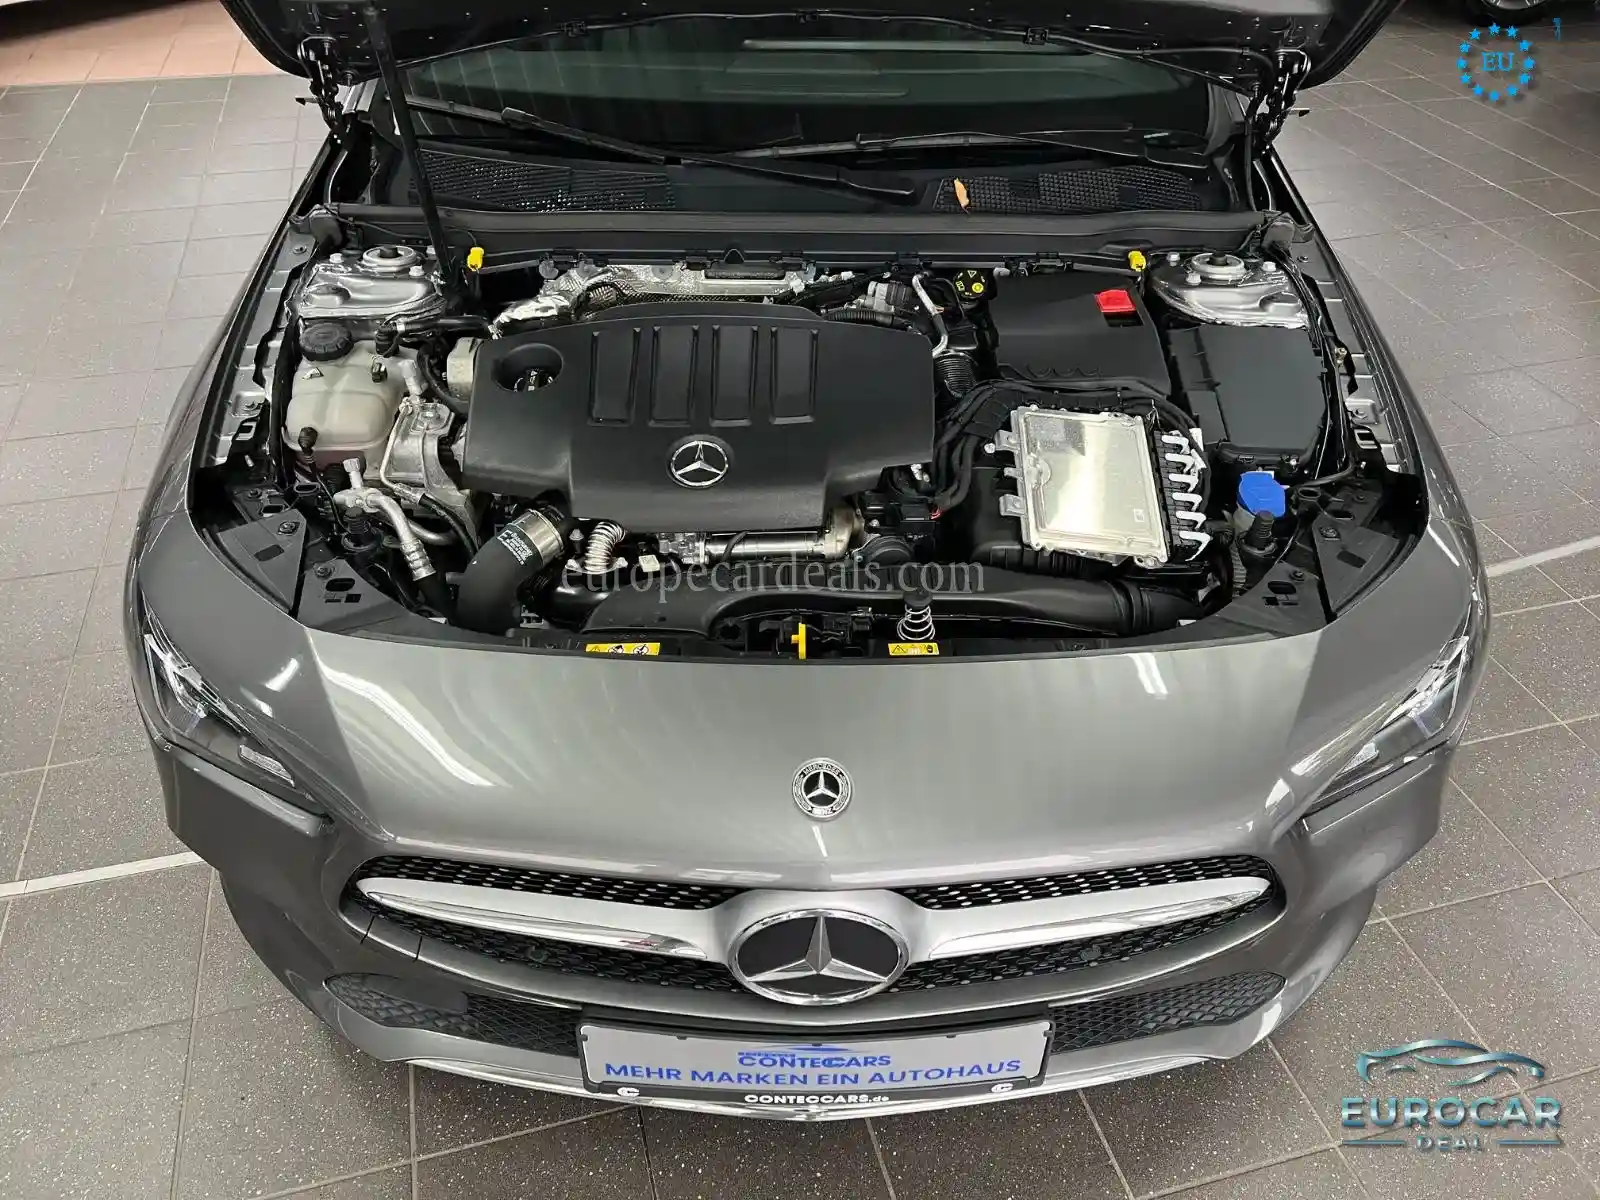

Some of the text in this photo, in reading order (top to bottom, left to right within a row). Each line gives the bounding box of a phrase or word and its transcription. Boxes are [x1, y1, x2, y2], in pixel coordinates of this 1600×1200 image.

[605, 1060, 1021, 1085] MEHR MARKEN EIN AUTOHAUS
[744, 1094, 889, 1104] CONTECCARS.de
